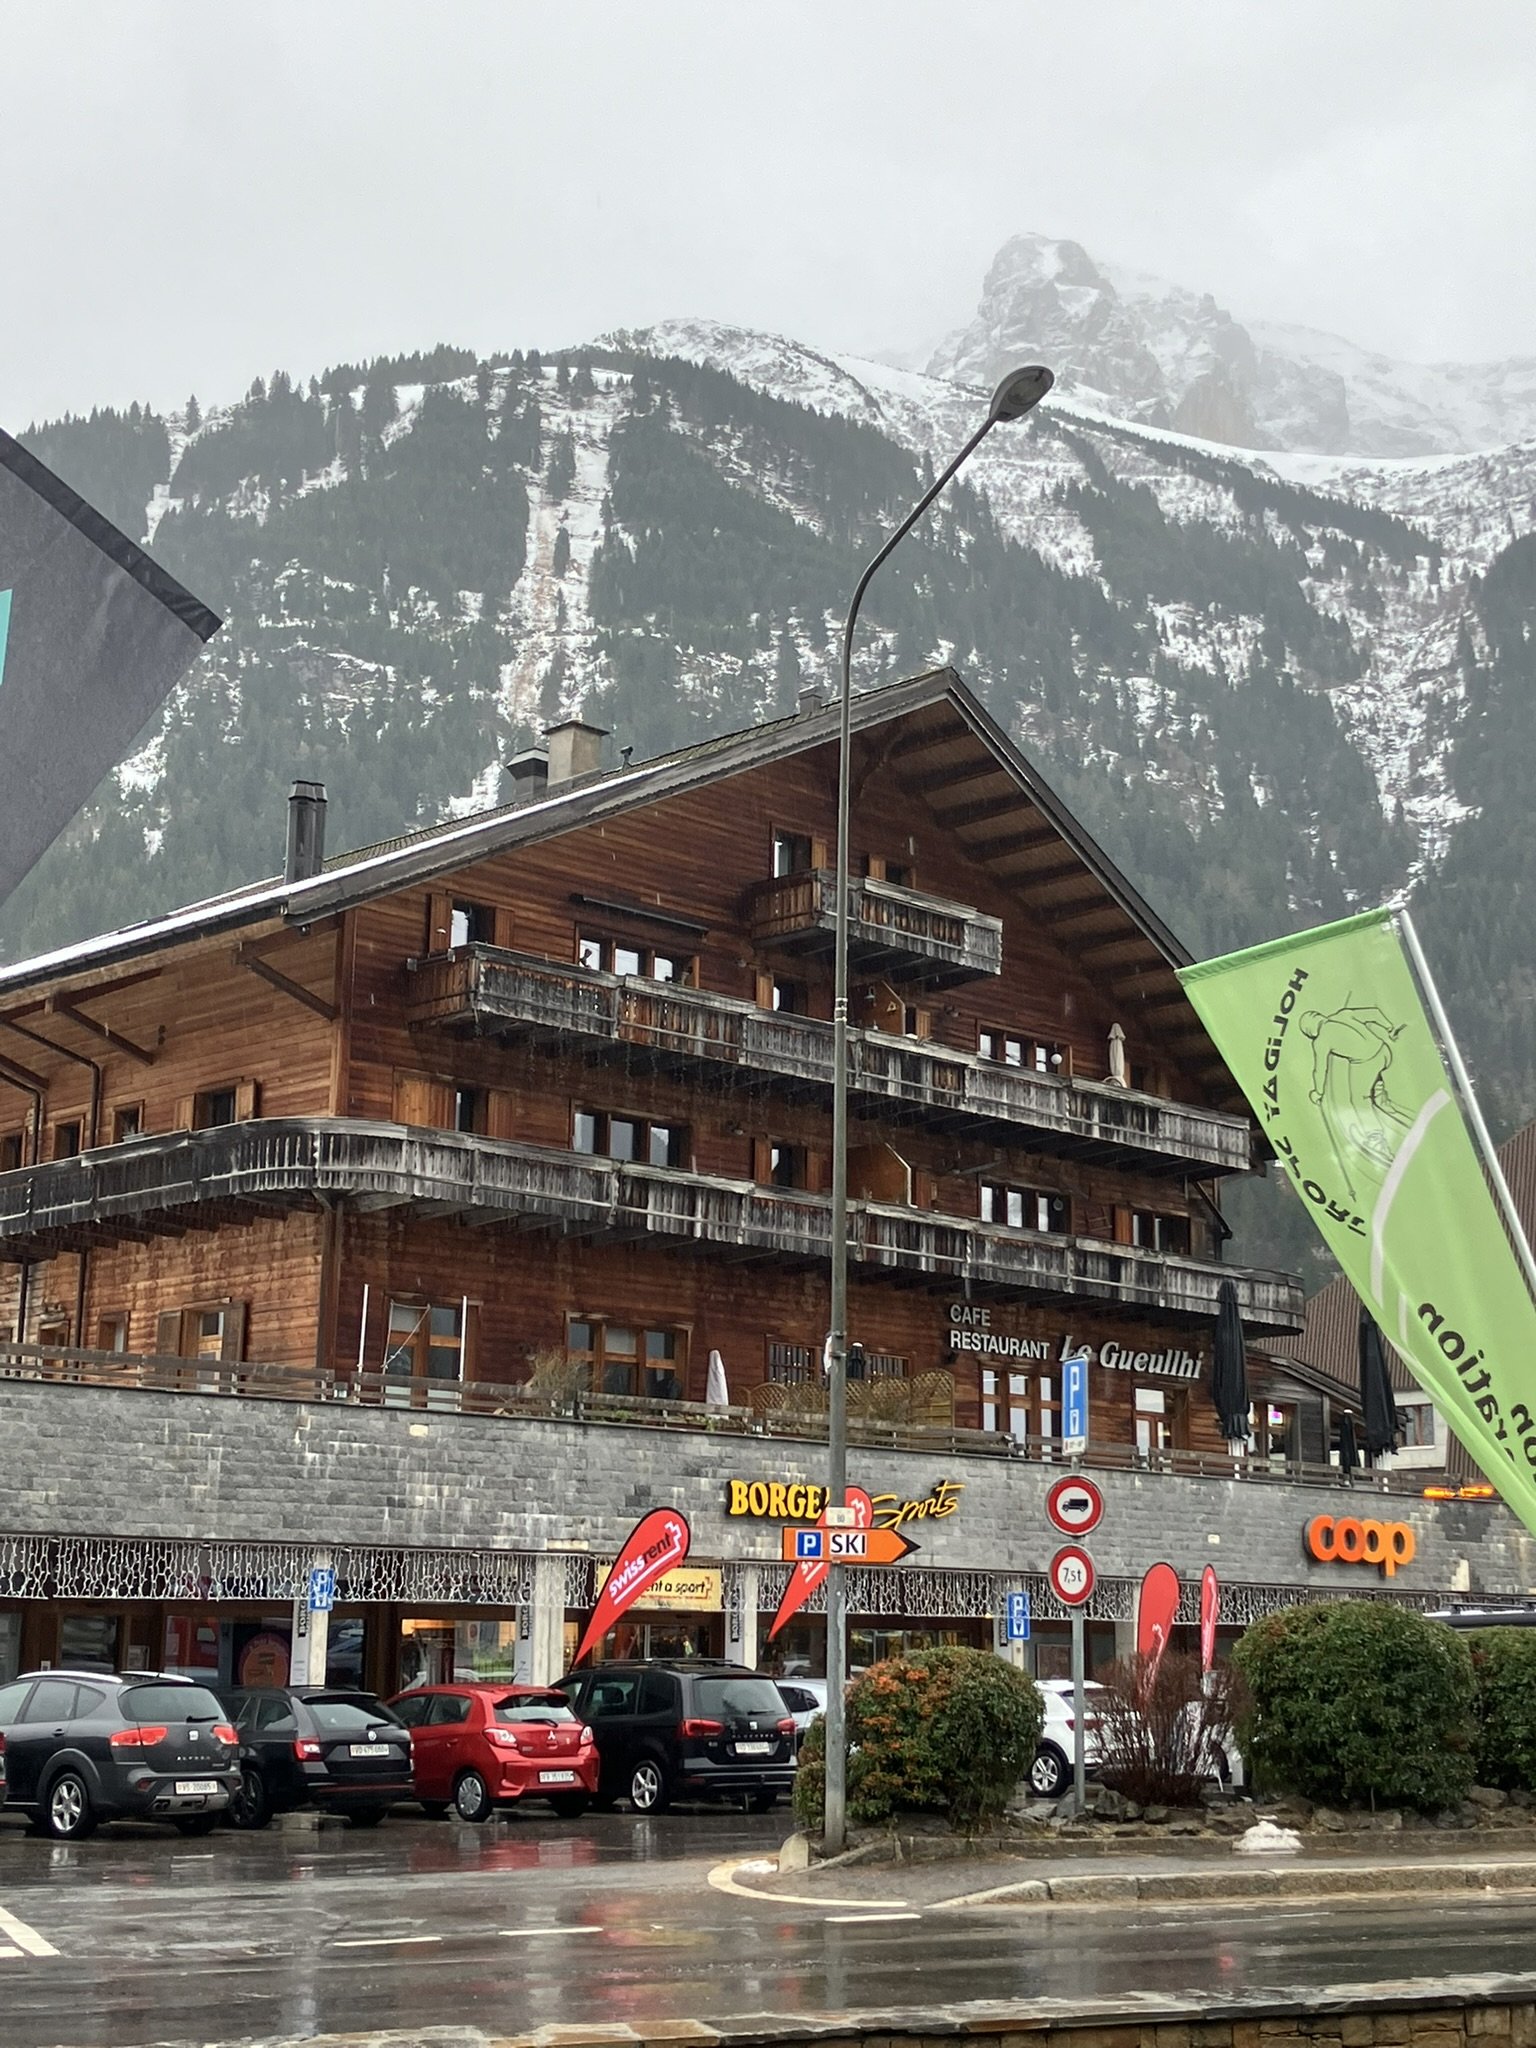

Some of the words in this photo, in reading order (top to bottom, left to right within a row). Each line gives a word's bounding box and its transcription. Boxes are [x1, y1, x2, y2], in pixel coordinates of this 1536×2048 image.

[950, 1330, 1050, 1360] RESTAURANT
[1100, 1341, 1204, 1379] Gueullhi
[730, 1480, 830, 1519] BORGE
[803, 1535, 817, 1555] P
[831, 1534, 866, 1554] SKI
[1308, 1514, 1416, 1577] coop
[664, 1582, 673, 1592] a
[675, 1581, 705, 1595] sport
